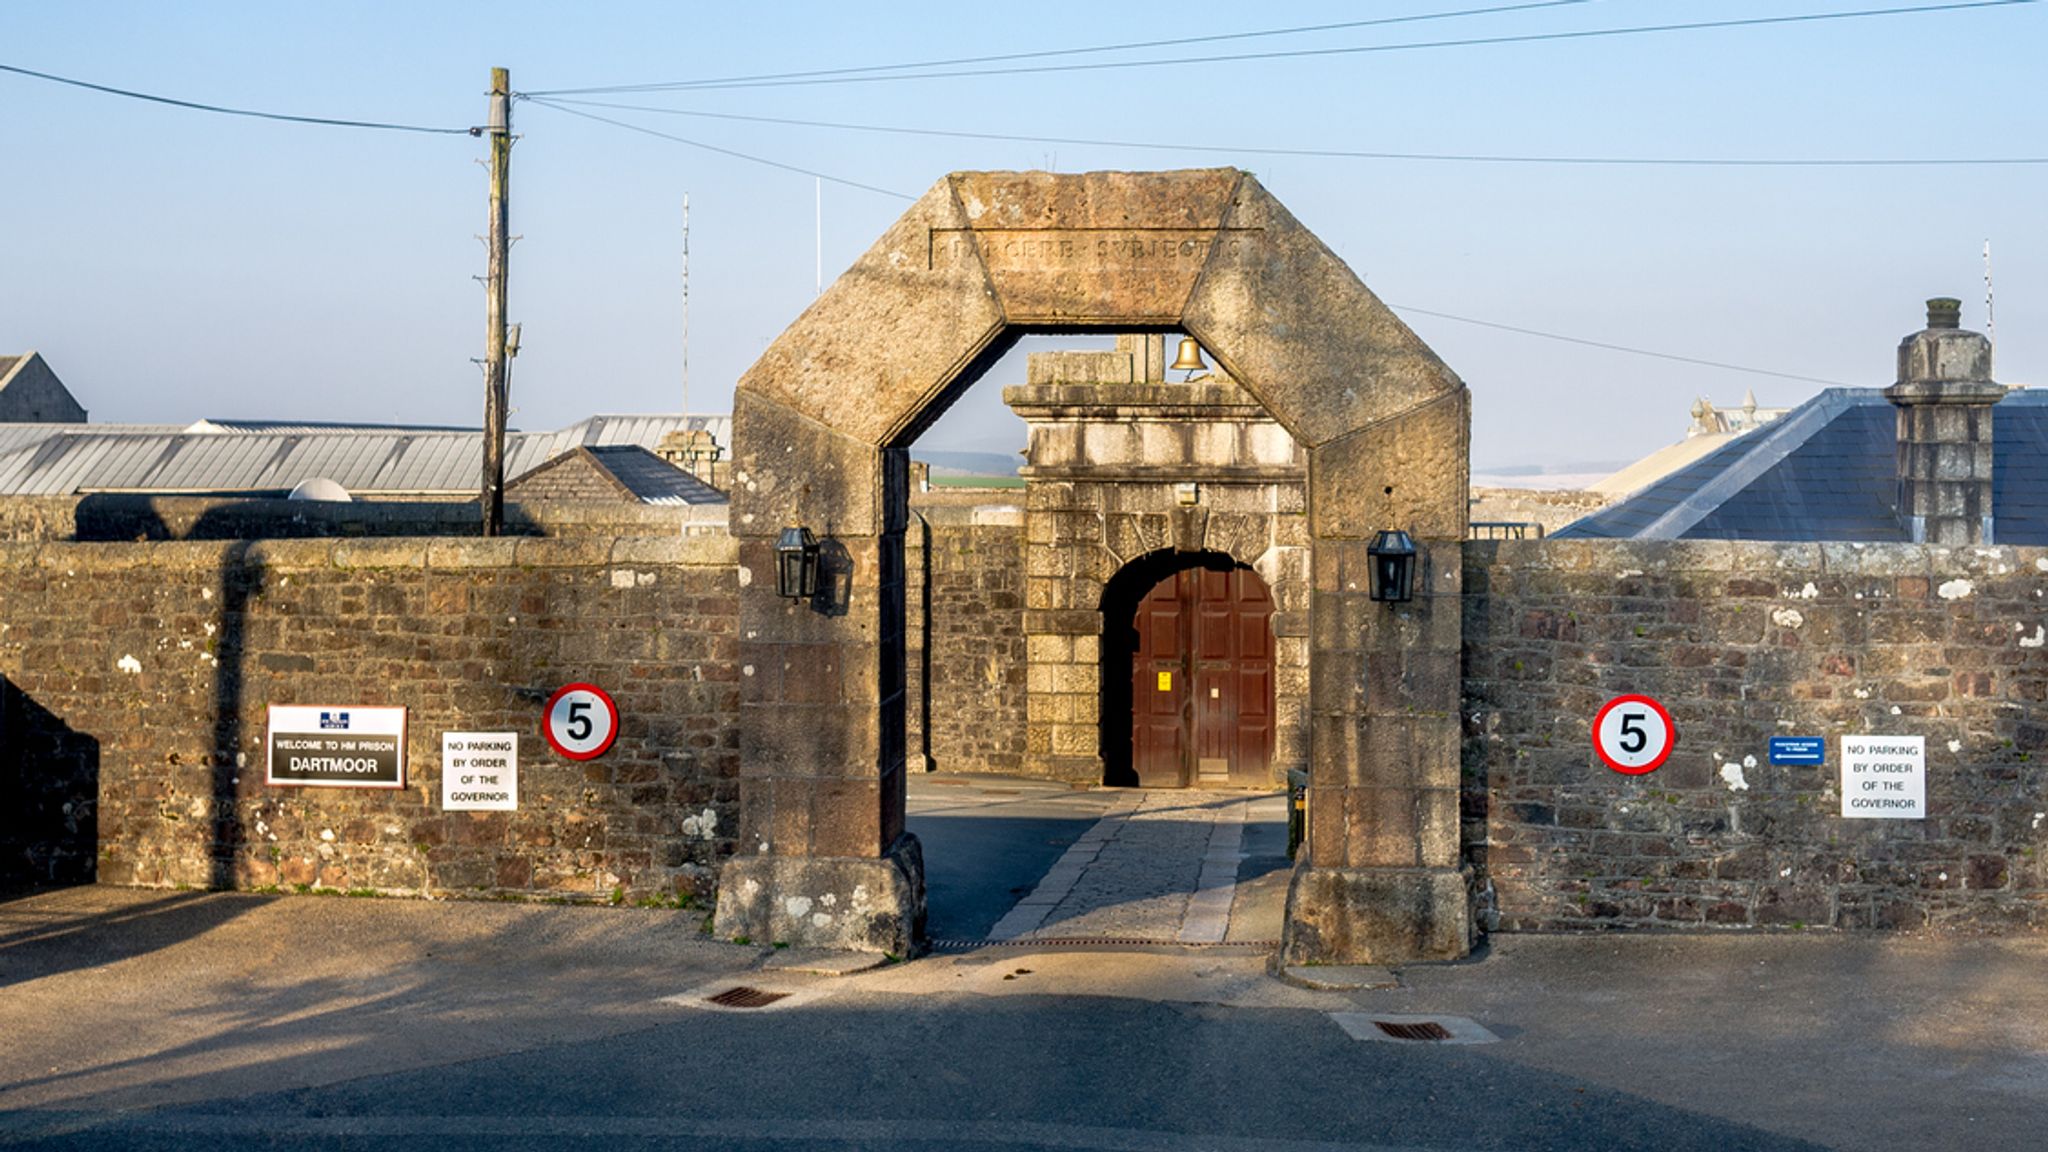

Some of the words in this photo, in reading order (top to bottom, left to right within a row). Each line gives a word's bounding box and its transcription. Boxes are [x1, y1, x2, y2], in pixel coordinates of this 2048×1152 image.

[567, 703, 593, 740] 5
[1619, 713, 1647, 753] 5
[276, 739, 322, 751] WELCOME
[325, 740, 338, 751] TO
[341, 741, 356, 751] HM
[359, 741, 395, 752] PRISON
[448, 741, 464, 751] NO
[467, 741, 512, 752] PARKING
[1848, 745, 1865, 755] NO
[1869, 745, 1919, 756] PARKING
[290, 757, 378, 773] DARTMOOR
[453, 758, 467, 768] BY
[470, 758, 507, 768] ORDER
[1853, 763, 1868, 773] BY
[1873, 763, 1913, 773] ORDER
[460, 775, 475, 785] OF
[479, 775, 499, 785] THE
[1862, 781, 1878, 791] OF
[1882, 781, 1905, 791] THE
[451, 792, 509, 802] GOVERNOR
[1851, 798, 1916, 809] GOVERNOR
